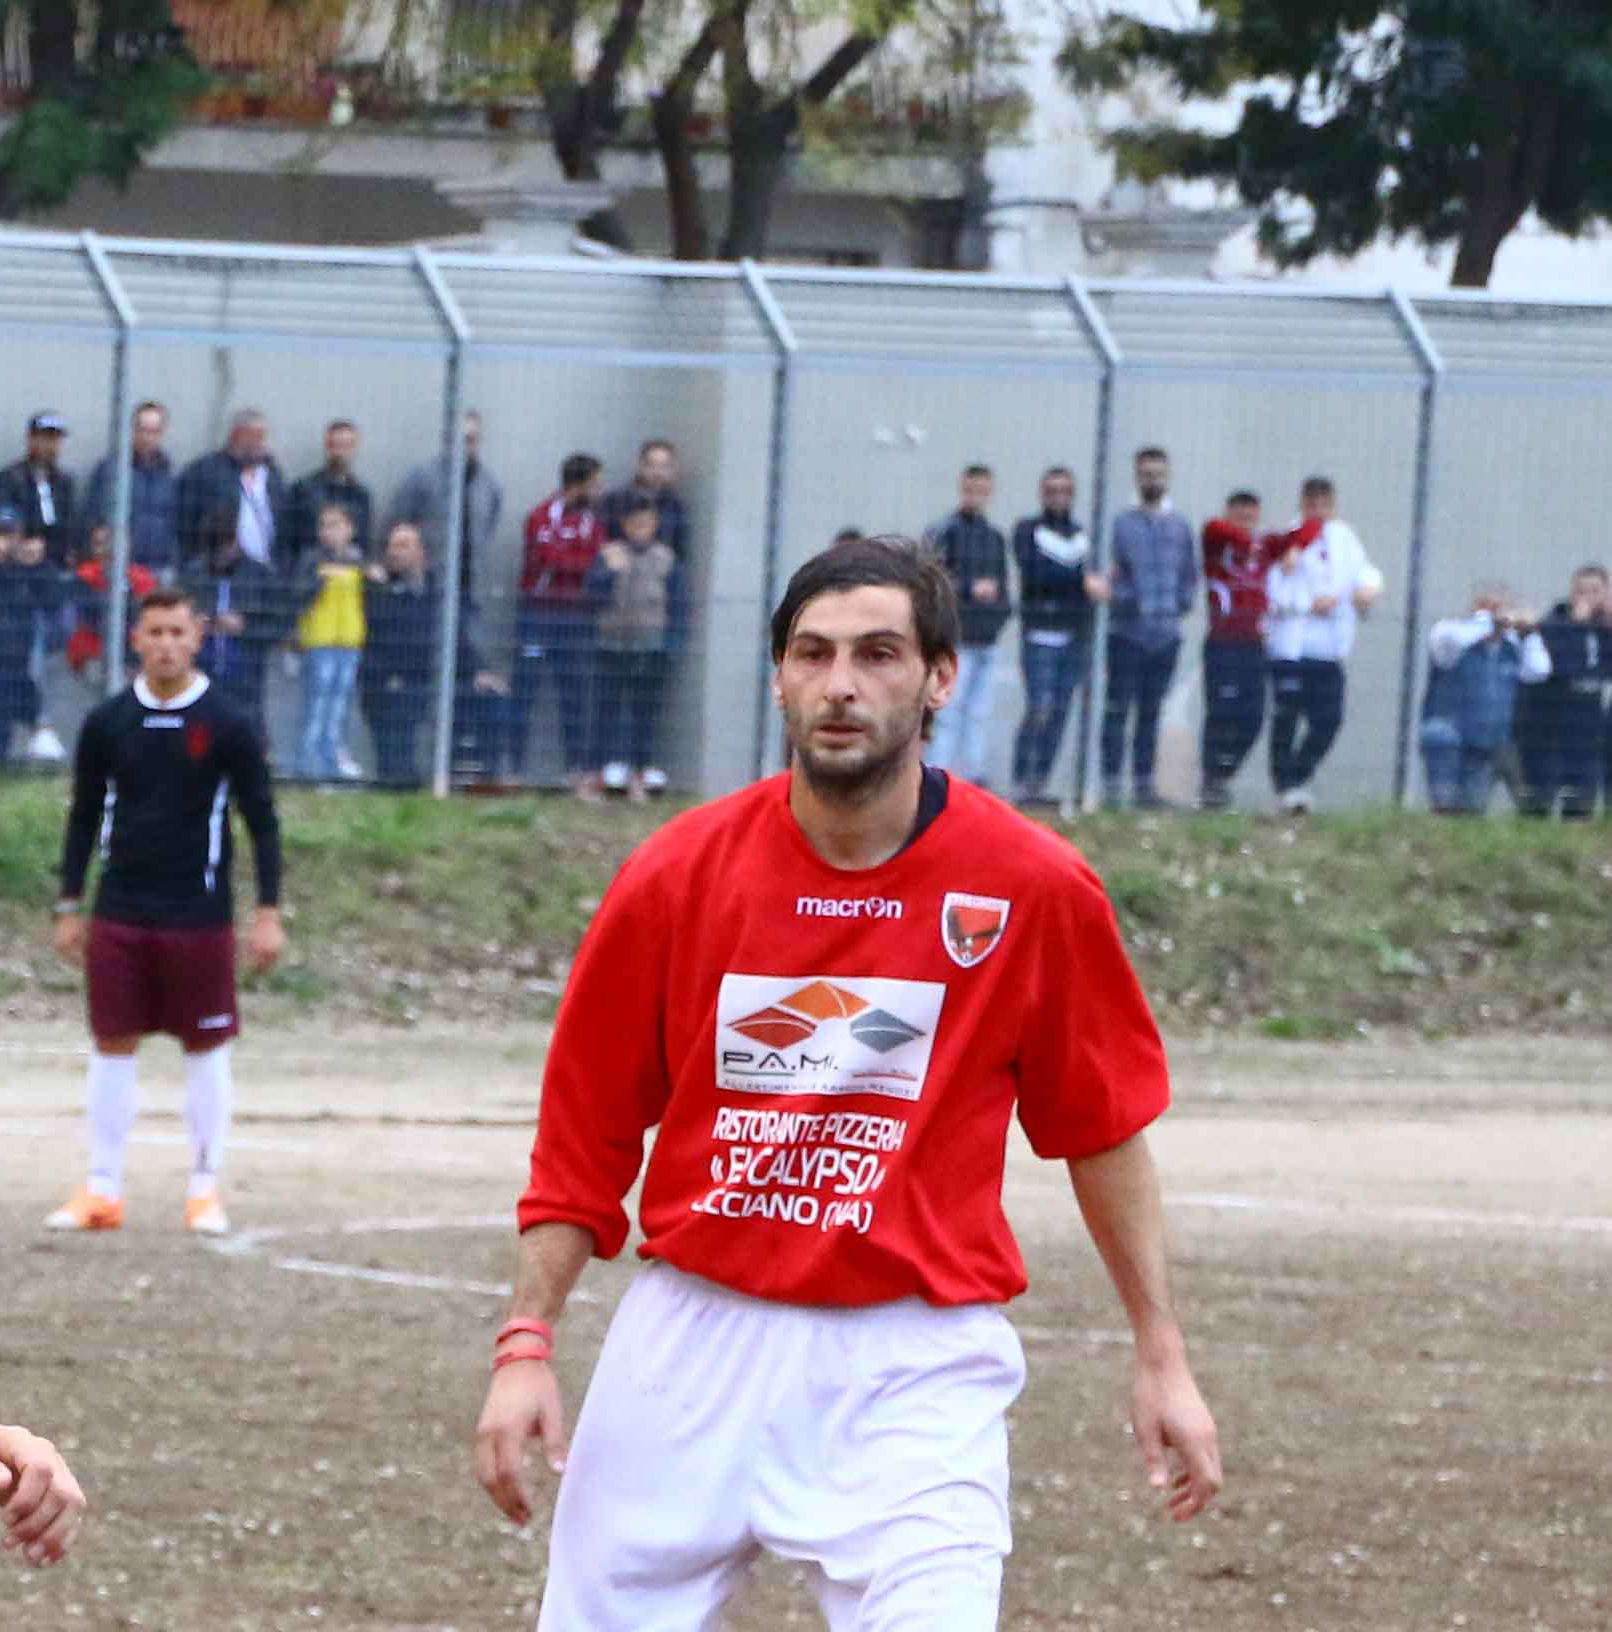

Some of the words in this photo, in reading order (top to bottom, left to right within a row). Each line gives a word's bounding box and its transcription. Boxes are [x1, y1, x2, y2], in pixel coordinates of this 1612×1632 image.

[796, 896, 903, 919] macron
[711, 1106, 825, 1144] RISTORANTE
[820, 1112, 907, 1152] PIZZERIA
